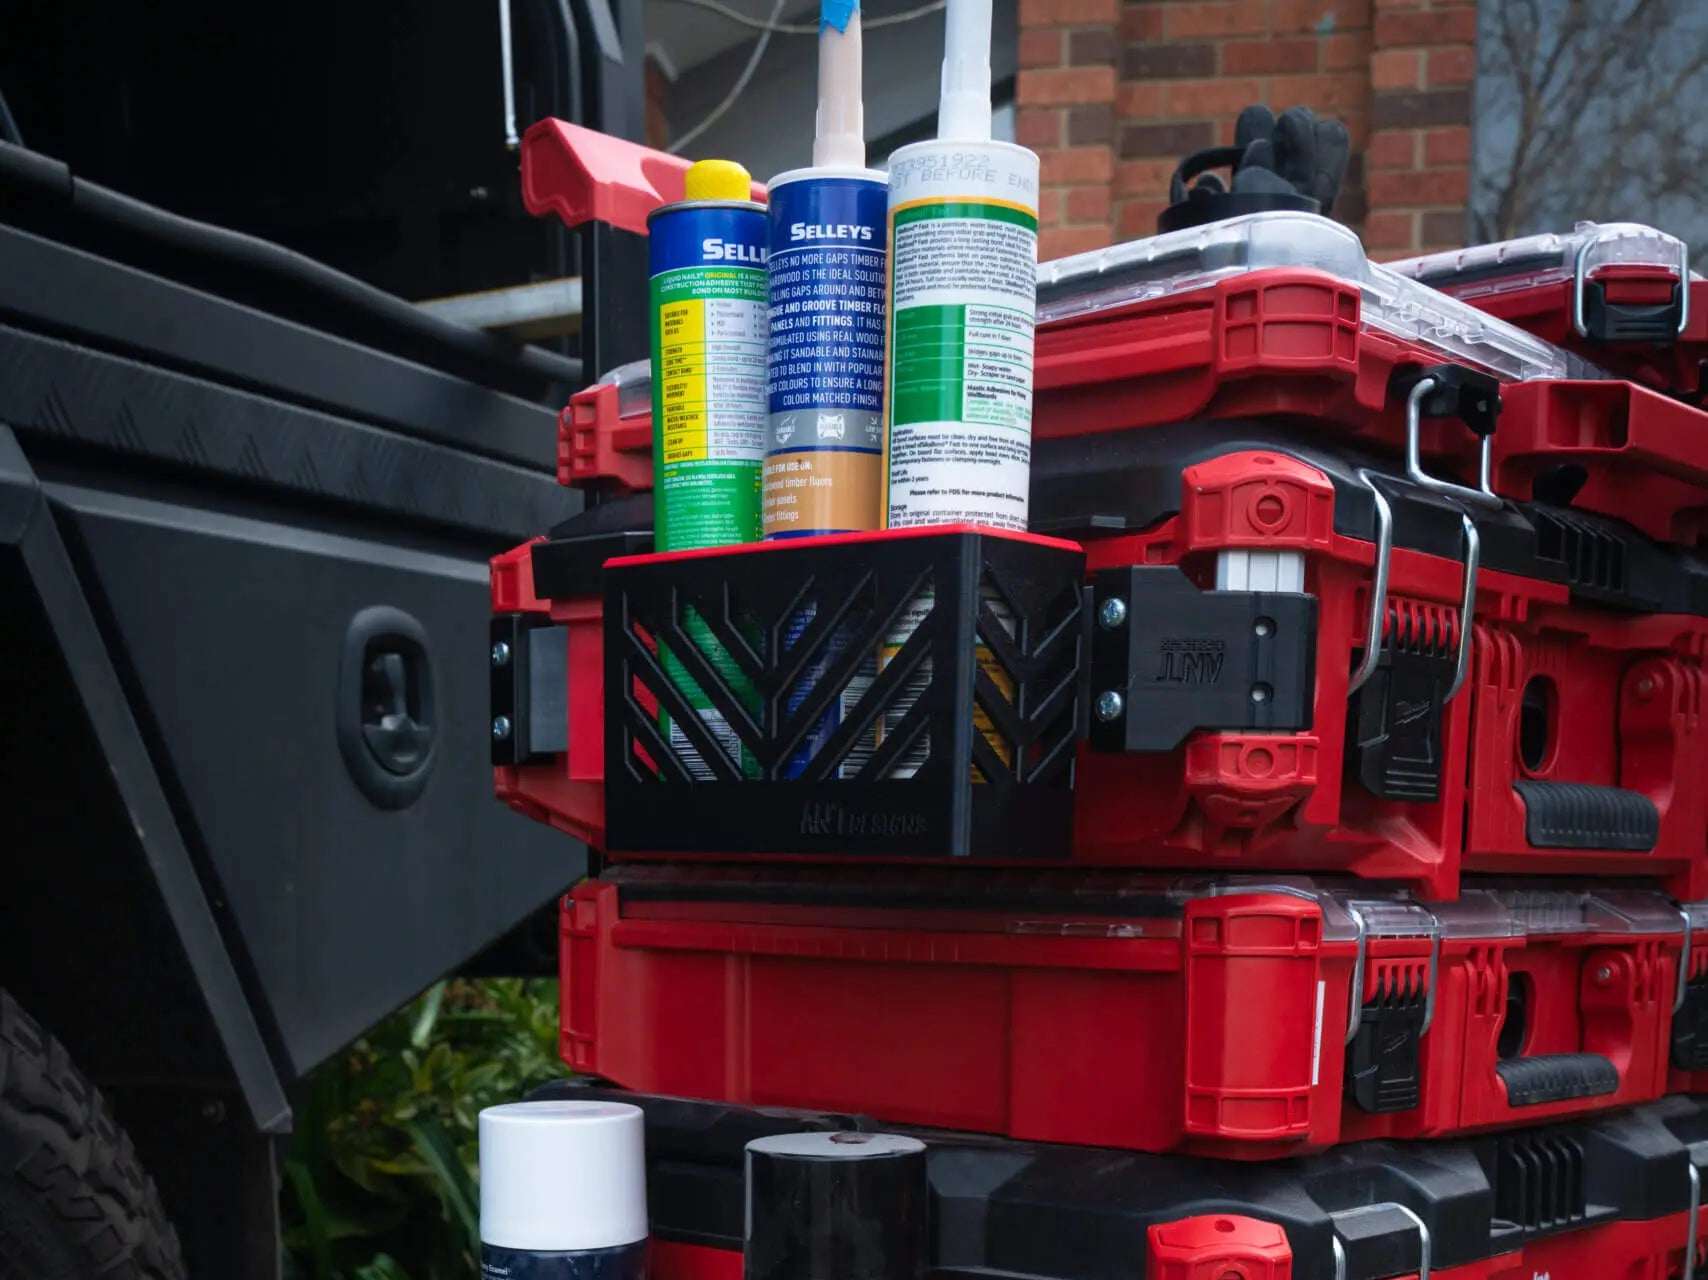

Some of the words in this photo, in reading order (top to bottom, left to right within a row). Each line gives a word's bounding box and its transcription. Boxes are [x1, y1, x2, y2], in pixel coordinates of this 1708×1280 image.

[791, 222, 872, 240] SELLEYS
[790, 255, 800, 267] NO
[802, 254, 824, 265] MORE
[826, 254, 848, 264] GAPS
[851, 254, 879, 267] TIMBER
[803, 270, 810, 281] IS
[812, 269, 827, 279] THE
[829, 269, 852, 280] IDEAL
[855, 270, 885, 284] SOLUTIO
[792, 285, 811, 297] GAPS
[813, 285, 847, 295] AROUND
[849, 285, 865, 296] AND
[785, 302, 800, 313] AND
[802, 300, 837, 312] GROOVE
[839, 300, 871, 312] TIMBER
[795, 316, 810, 327] AND
[813, 315, 855, 327] FITTINGS.
[857, 317, 864, 327] IT
[866, 318, 881, 329] HAS
[807, 331, 830, 342] USING
[833, 331, 853, 342] REAL
[856, 333, 879, 344] WOOD
[791, 346, 830, 359] SANDABLE
[831, 346, 850, 357] AND
[852, 347, 884, 360] STAINAB
[780, 366, 787, 377] TO
[789, 362, 811, 374] BLEND
[814, 362, 822, 372] IN
[824, 362, 845, 372] WITH
[848, 362, 882, 376] POPULAR
[779, 378, 808, 391] COLOURS
[811, 378, 820, 388] TO
[823, 377, 854, 388] ENSURE
[856, 379, 862, 389] A
[784, 394, 810, 405] COLOUR
[813, 392, 850, 403] MATCHED
